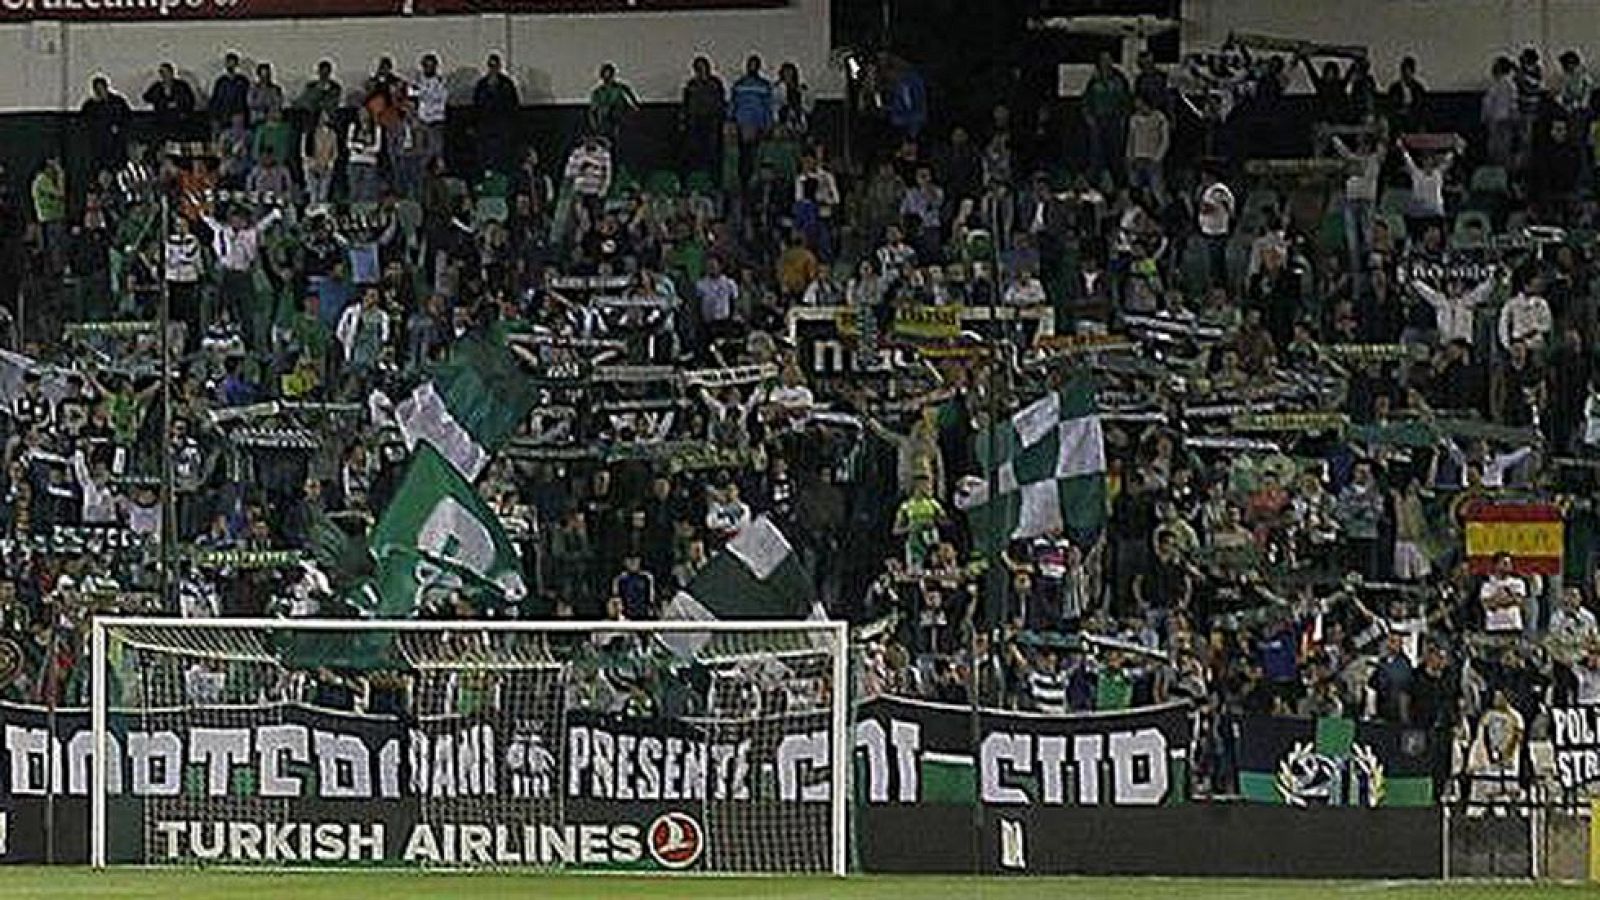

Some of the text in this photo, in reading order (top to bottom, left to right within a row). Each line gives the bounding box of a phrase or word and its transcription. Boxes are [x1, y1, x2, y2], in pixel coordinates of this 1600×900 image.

[568, 725, 751, 800] PRESENTE
[159, 821, 643, 864] TURKISH AIRLINES
